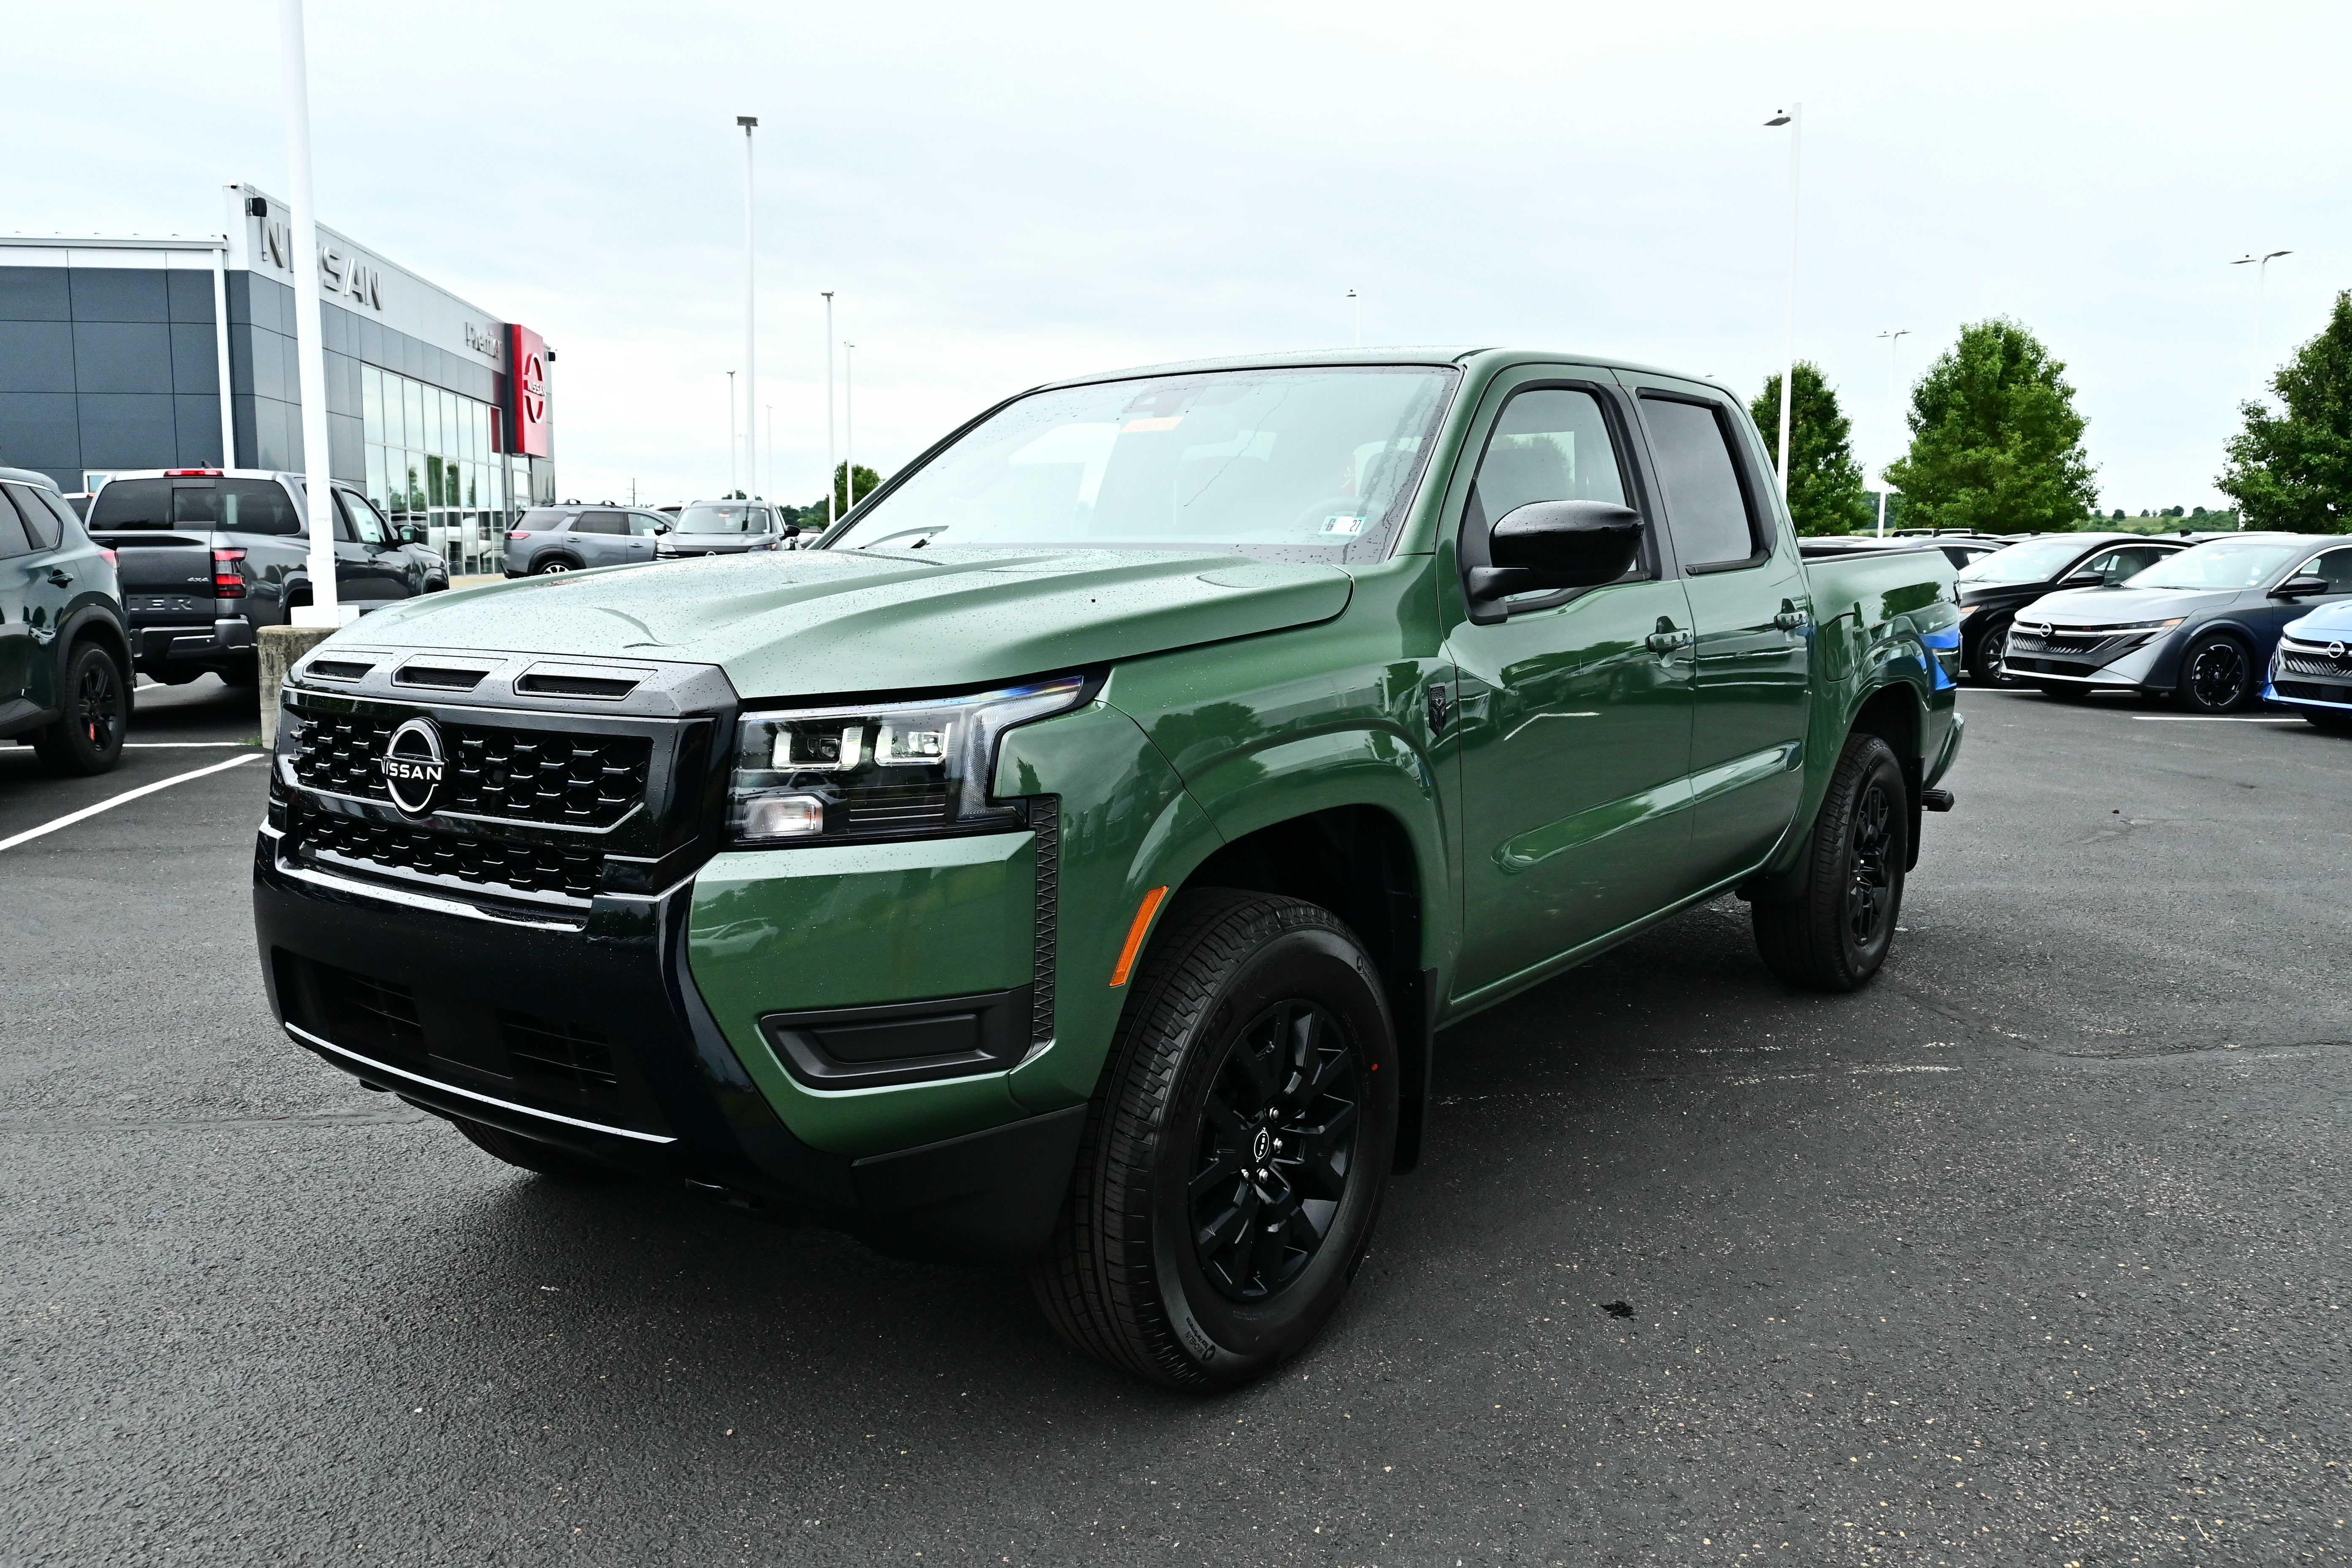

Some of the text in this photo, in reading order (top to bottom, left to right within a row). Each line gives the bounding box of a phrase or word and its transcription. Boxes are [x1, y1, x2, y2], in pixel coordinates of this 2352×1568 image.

[261, 215, 382, 311] NISAN
[528, 380, 546, 396] NISSAN
[1326, 518, 1362, 532] 6 27
[381, 759, 442, 781] NISSAN
[1184, 1331, 1205, 1354] MICHELIN
